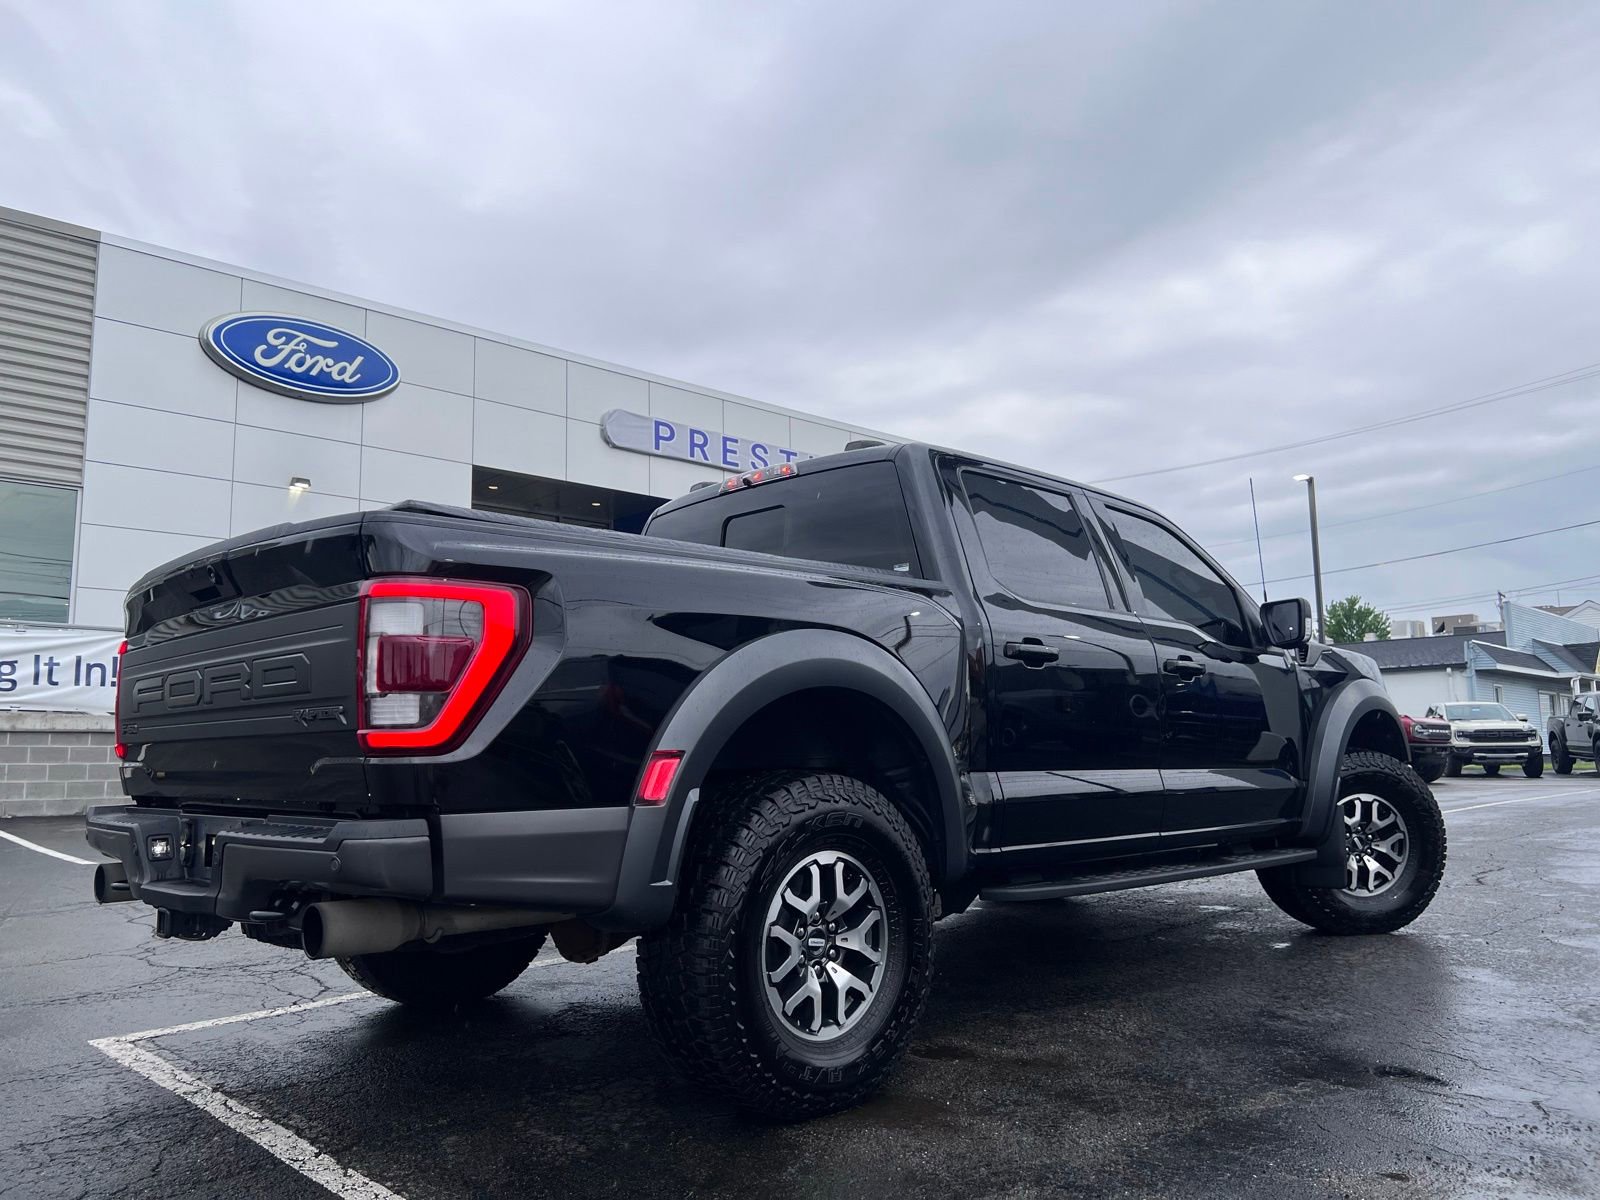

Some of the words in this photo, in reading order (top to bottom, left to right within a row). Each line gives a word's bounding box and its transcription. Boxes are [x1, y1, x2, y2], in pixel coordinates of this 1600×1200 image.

[254, 328, 364, 383] Ford
[654, 419, 813, 471] PREST
[33, 654, 60, 686] It
[74, 655, 118, 687] In!
[132, 652, 312, 713] FORD
